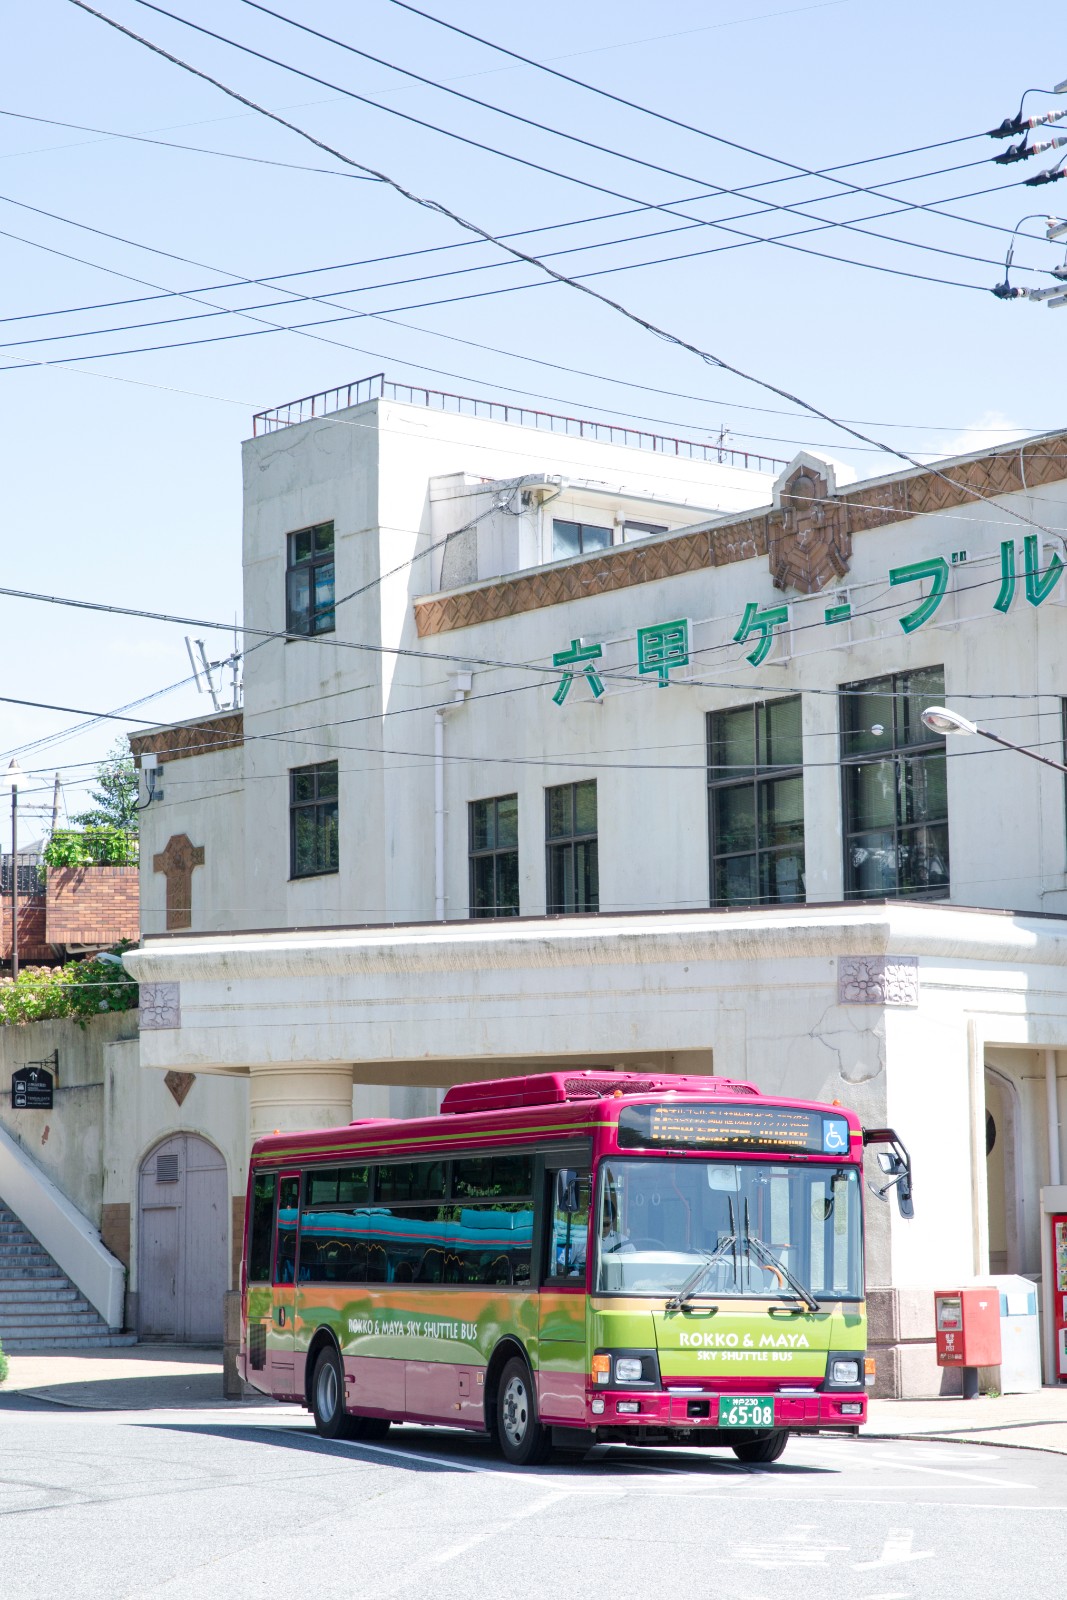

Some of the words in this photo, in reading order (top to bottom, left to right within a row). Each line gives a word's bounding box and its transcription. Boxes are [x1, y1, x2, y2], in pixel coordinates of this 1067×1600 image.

[553, 534, 1065, 706] 六甲ケーブル
[348, 1319, 374, 1335] ROKKO
[374, 1320, 380, 1335] &
[381, 1321, 404, 1336] MAYA
[407, 1321, 421, 1336] SKY
[423, 1322, 458, 1339] SHUTTLE
[461, 1324, 478, 1340] BUS
[679, 1332, 739, 1347] ROKKO
[742, 1333, 754, 1347] &
[758, 1334, 810, 1348] MAYA
[697, 1350, 716, 1361] SKY
[721, 1351, 768, 1361] SHUTTLE
[772, 1351, 793, 1361] BUS
[728, 1406, 772, 1425] 65-08
